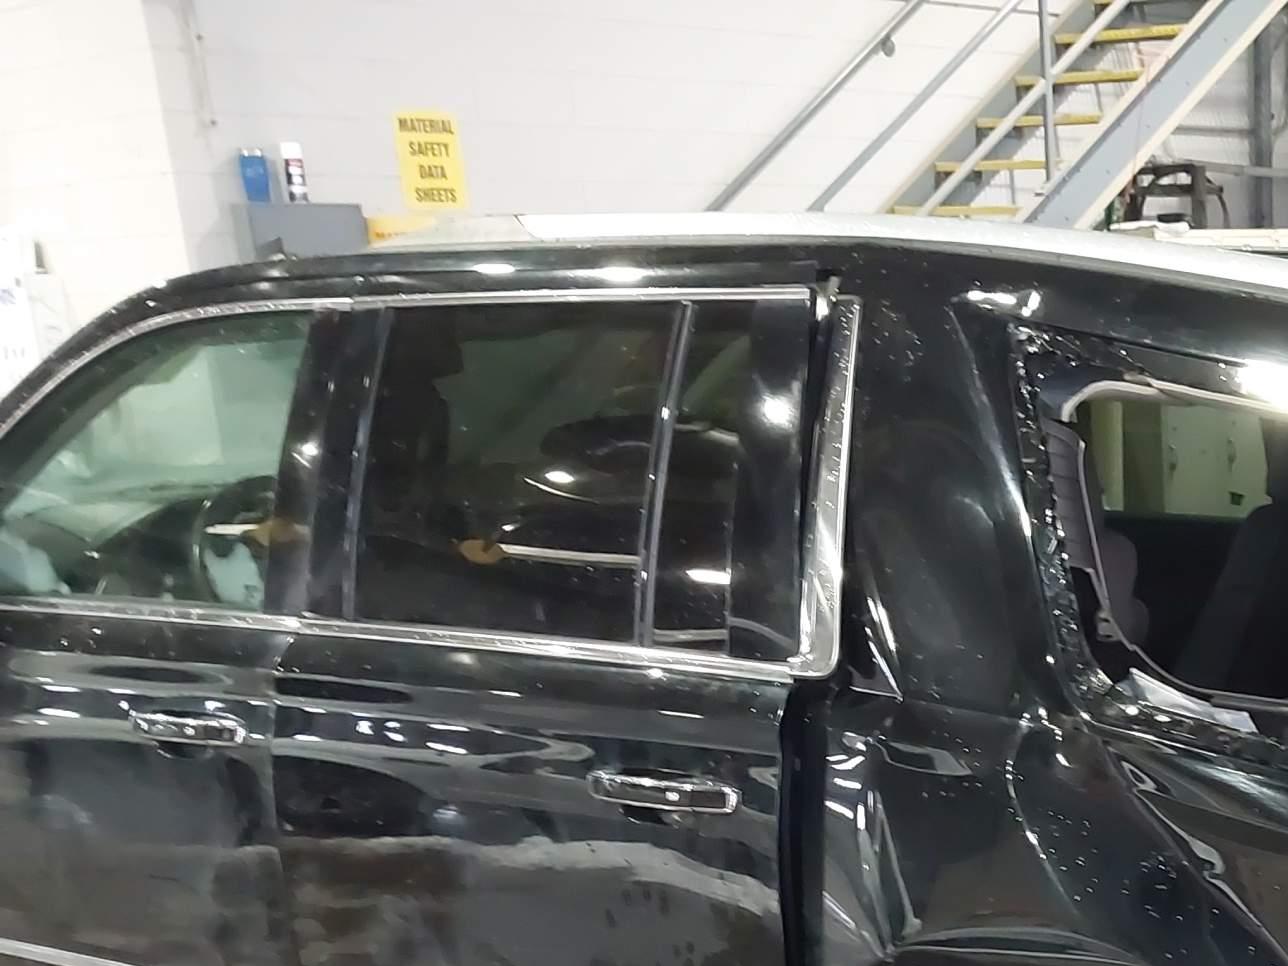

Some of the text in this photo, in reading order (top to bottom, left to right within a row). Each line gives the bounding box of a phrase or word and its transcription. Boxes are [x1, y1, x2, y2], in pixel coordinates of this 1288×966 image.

[398, 118, 453, 134] MATERIAL
[409, 141, 449, 157] SAFETY
[419, 164, 447, 179] DATA
[415, 187, 457, 202] SHEETS
